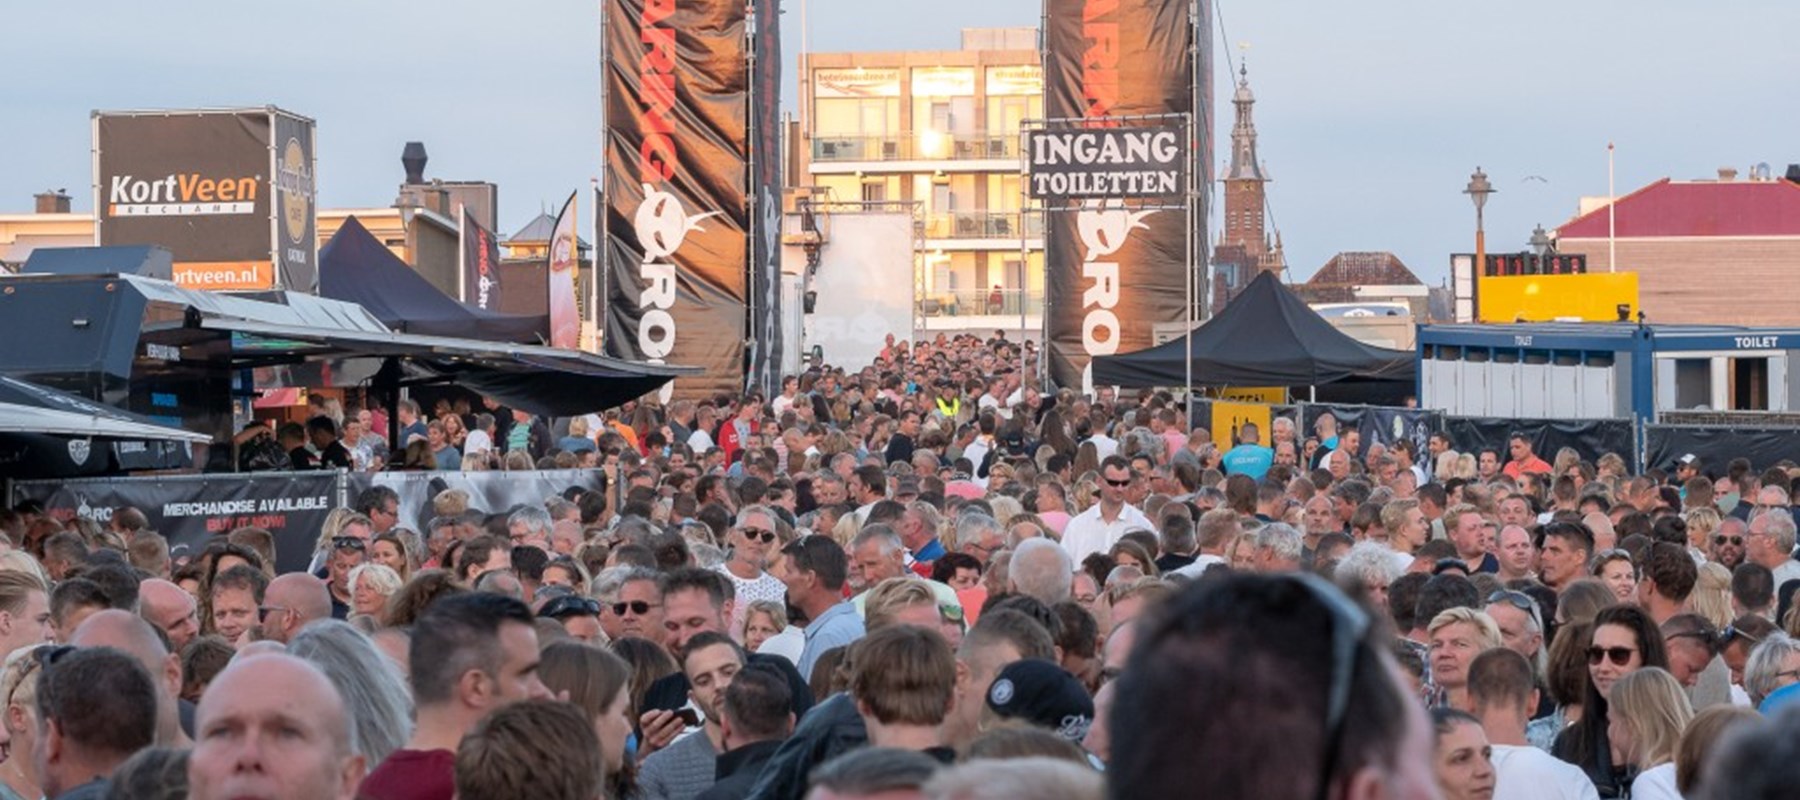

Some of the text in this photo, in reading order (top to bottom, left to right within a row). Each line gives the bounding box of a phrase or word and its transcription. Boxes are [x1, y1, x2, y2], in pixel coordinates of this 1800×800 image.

[1033, 132, 1178, 165] INGANG
[110, 174, 258, 203] KortVeen
[1033, 171, 1178, 195] TOILETTEN
[127, 205, 238, 214] RECLAME
[1734, 336, 1779, 349] TOILET
[163, 496, 328, 517] MERCHANDISE AVAILABLE
[206, 517, 234, 531] BUY
[236, 517, 251, 530] IT
